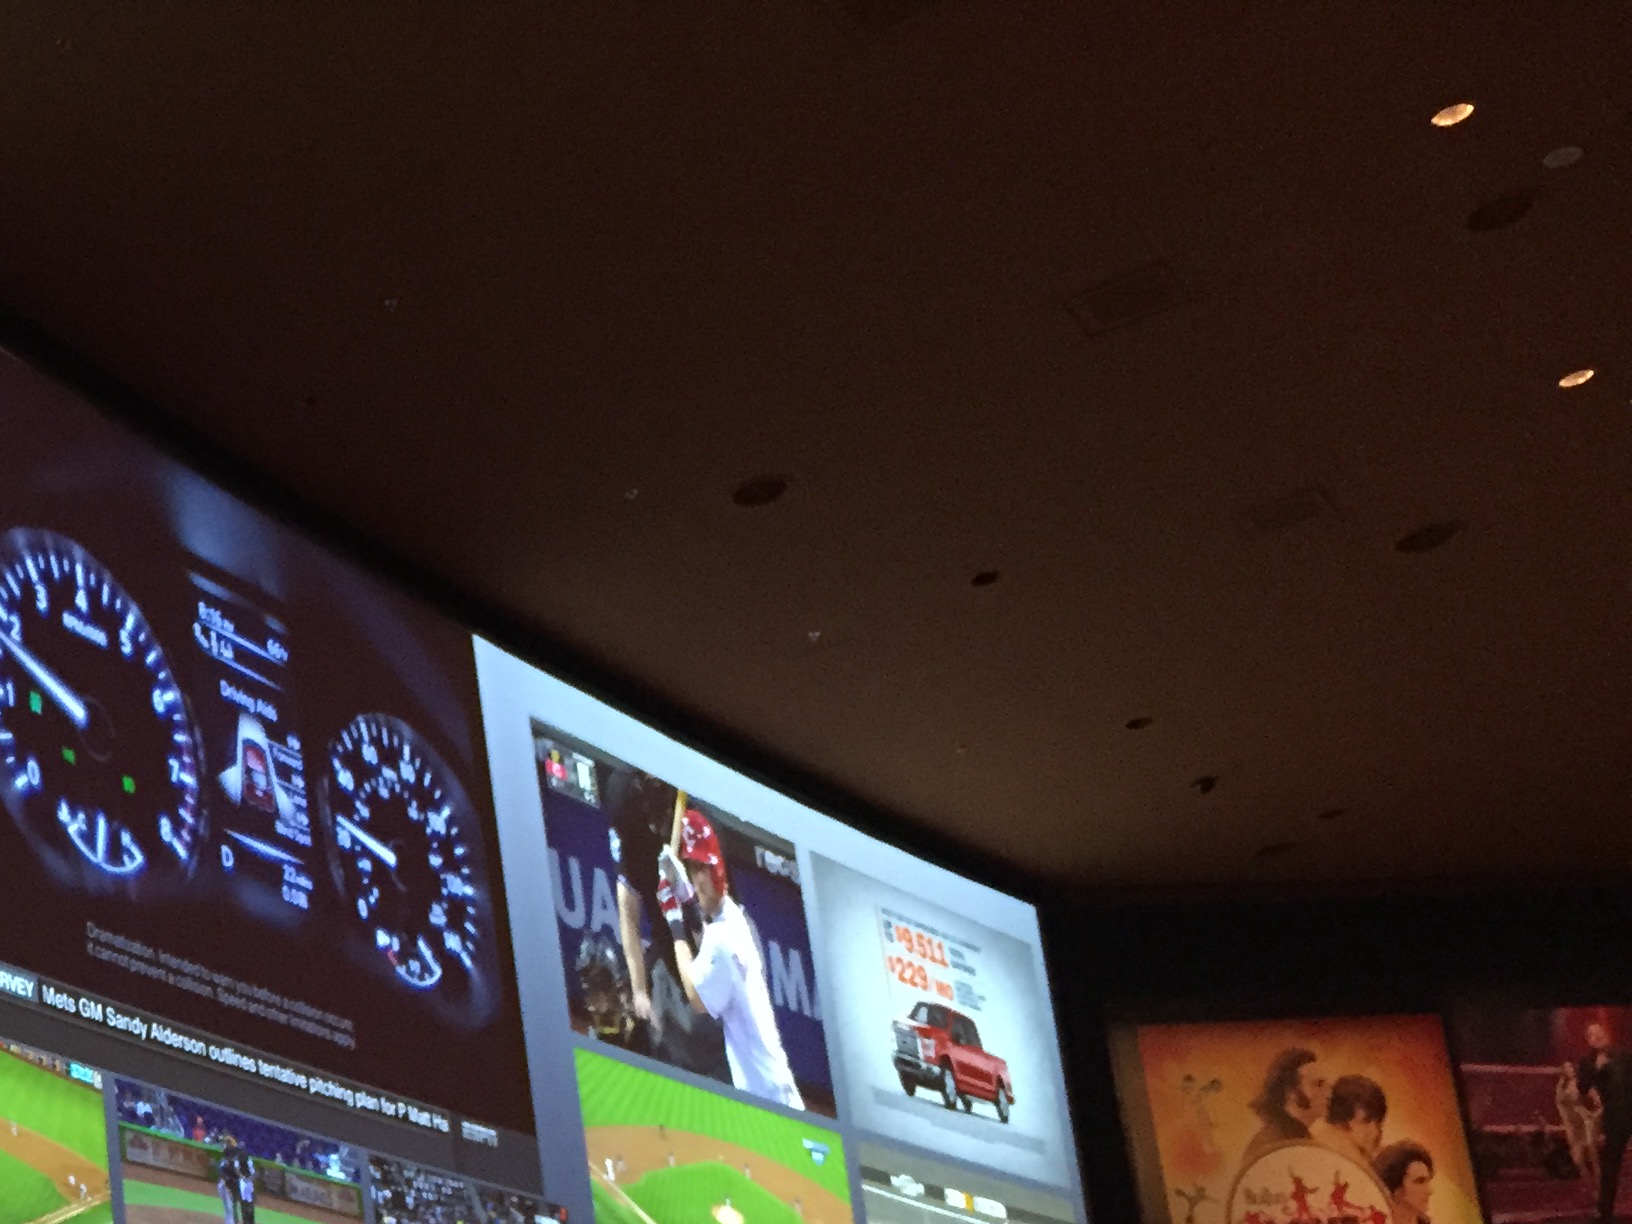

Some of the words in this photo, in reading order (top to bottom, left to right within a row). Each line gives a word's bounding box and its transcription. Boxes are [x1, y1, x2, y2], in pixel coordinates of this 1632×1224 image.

[42, 984, 76, 1014] Mets
[78, 997, 103, 1023] GM
[105, 1008, 147, 1041] Sandy
[149, 1022, 207, 1057] Alderson
[208, 1044, 258, 1074] outlines
